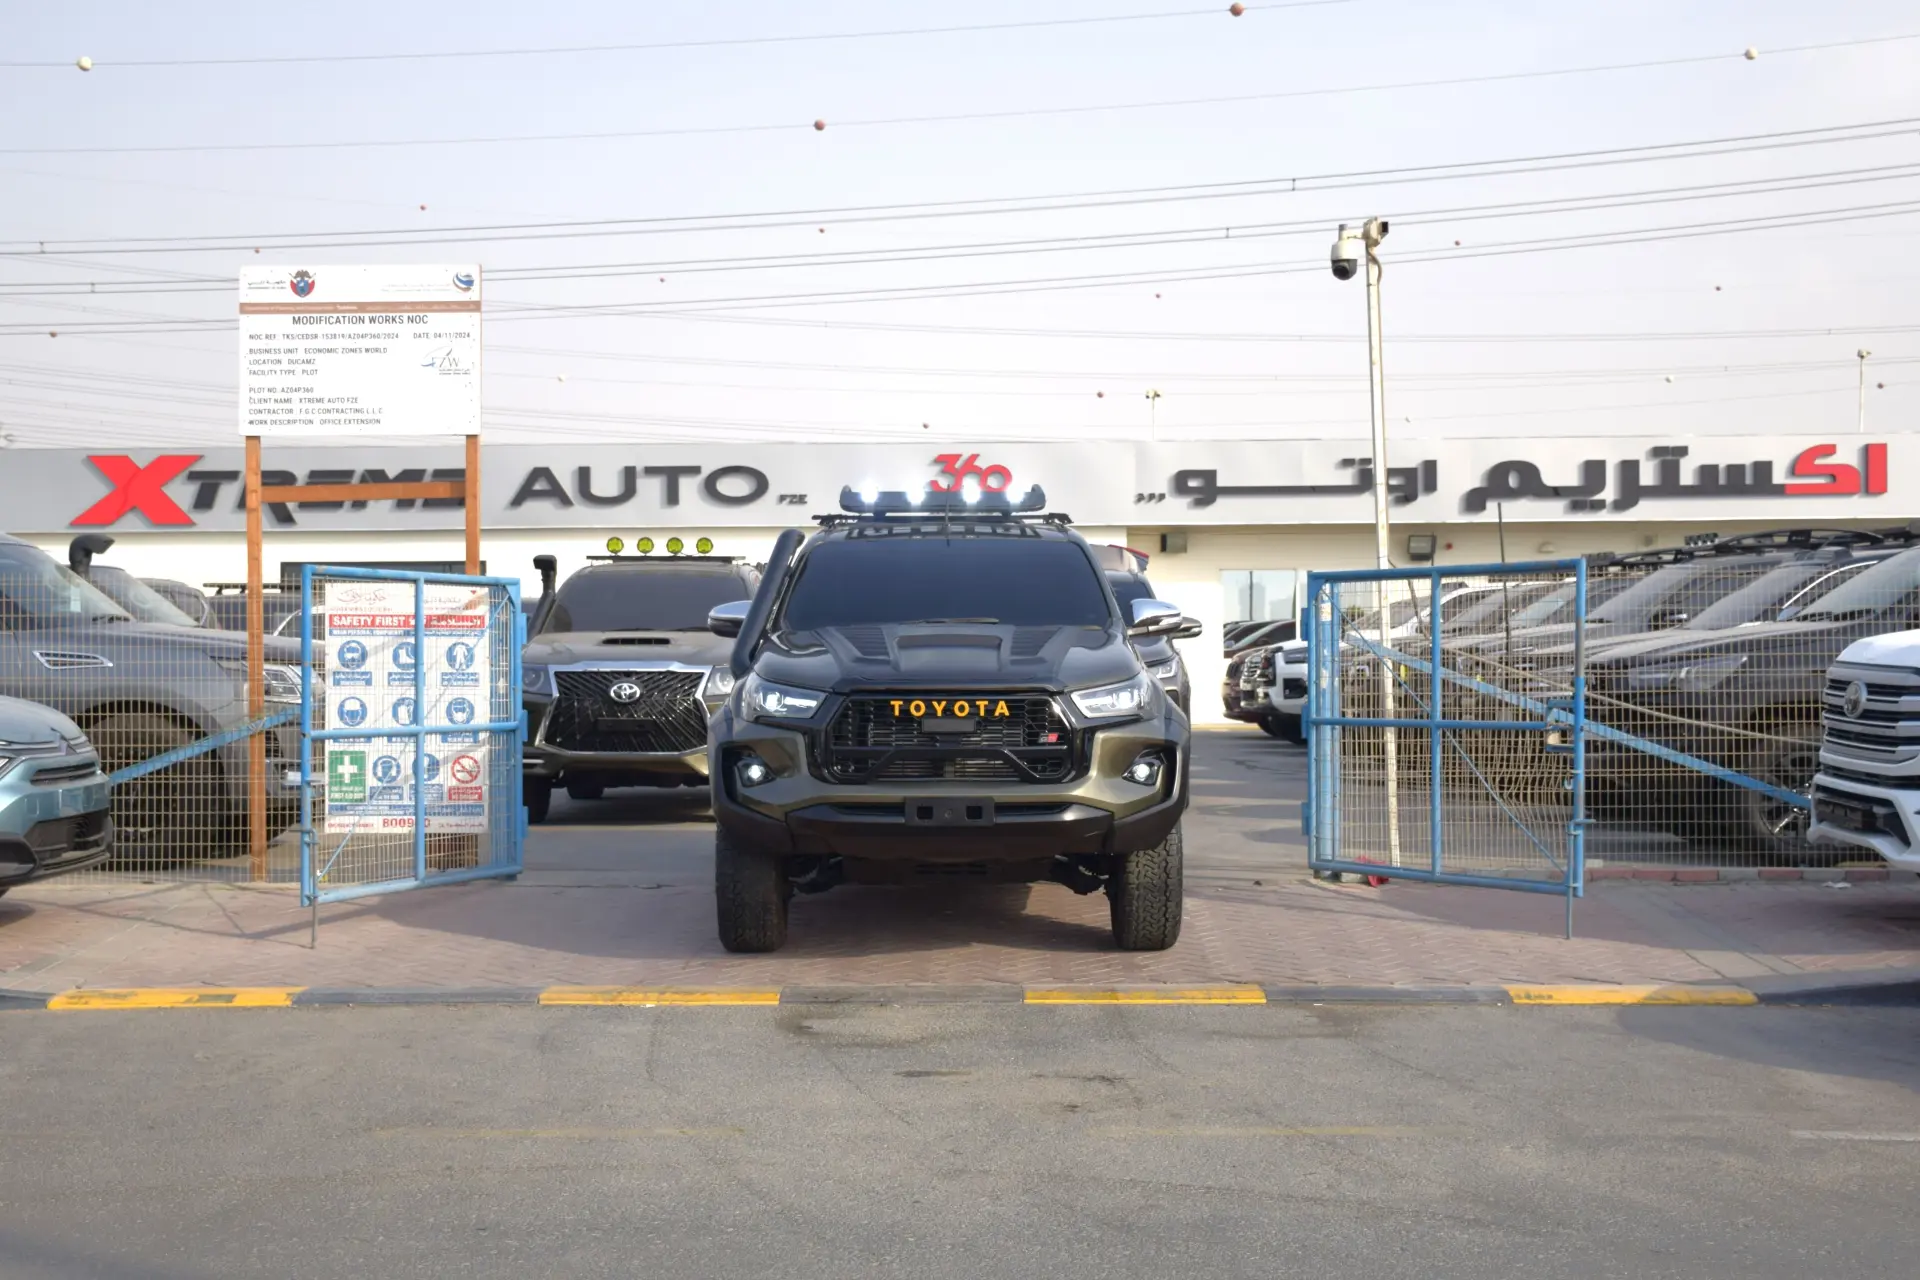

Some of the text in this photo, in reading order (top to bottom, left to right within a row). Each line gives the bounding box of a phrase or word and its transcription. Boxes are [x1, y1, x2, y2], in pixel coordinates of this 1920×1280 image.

[292, 314, 429, 325] MODIFICATION WORKS NOC
[248, 333, 263, 341] NOC
[304, 347, 339, 355] ECONOMIC
[301, 368, 318, 376] PLOT
[248, 397, 272, 405] CLIENT
[317, 407, 365, 415] CONTRACTING
[319, 418, 342, 426] OFFICE
[343, 418, 381, 426] EXTENSION
[929, 453, 1013, 493] 360
[69, 455, 808, 526] XTREME AUTO FZE
[332, 615, 405, 626] SAFETY FIRST
[890, 700, 1010, 717] TOYOTA
